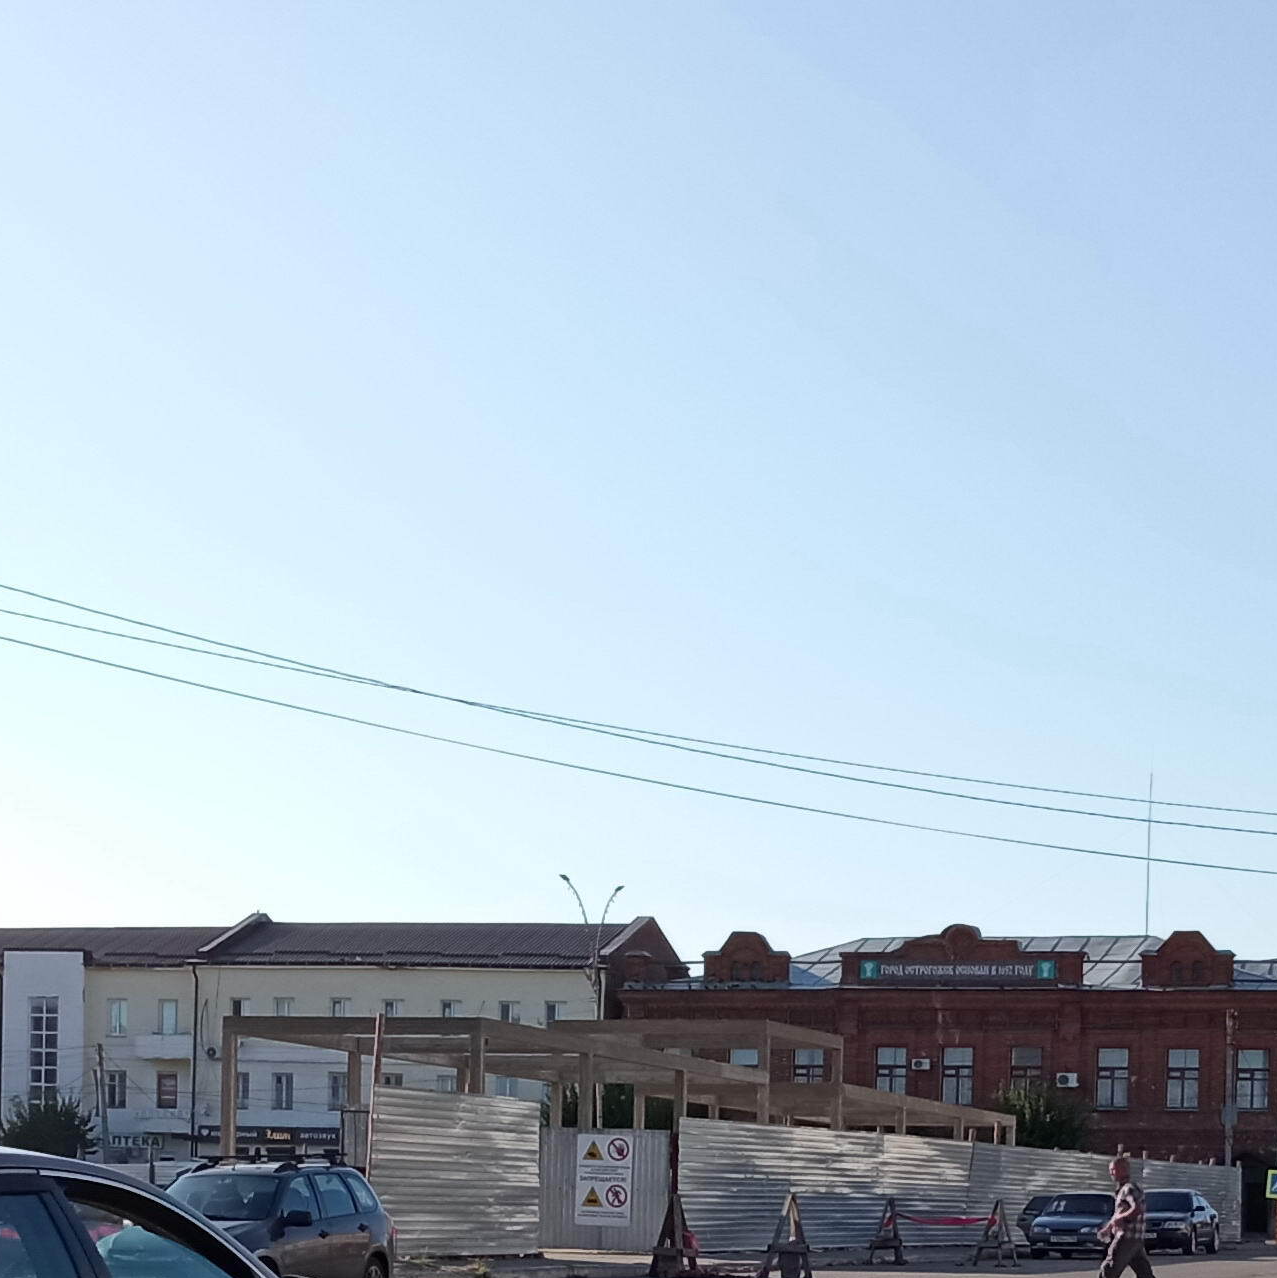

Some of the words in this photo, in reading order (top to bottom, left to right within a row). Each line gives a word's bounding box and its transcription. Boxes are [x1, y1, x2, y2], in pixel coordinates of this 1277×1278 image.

[880, 964, 904, 976] ГОРОД
[1014, 964, 1034, 976] ГОДУ
[108, 1135, 160, 1147] ПТЕКА
